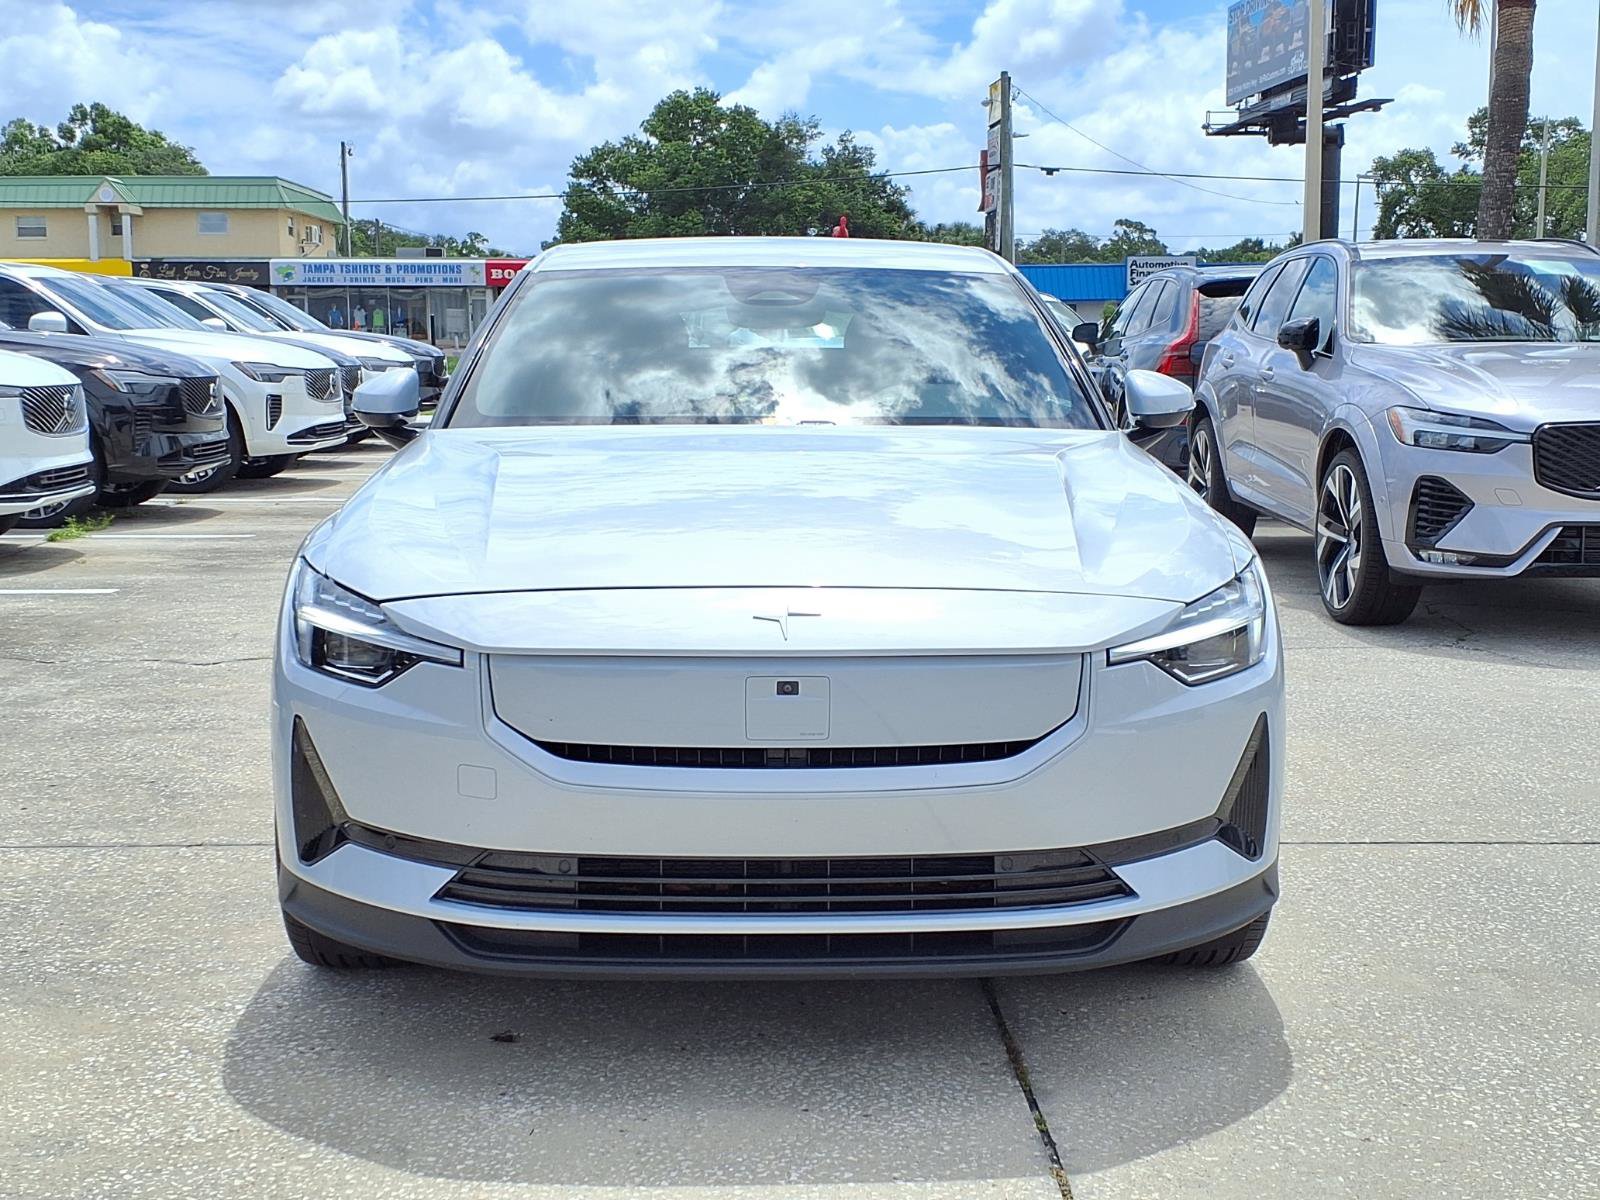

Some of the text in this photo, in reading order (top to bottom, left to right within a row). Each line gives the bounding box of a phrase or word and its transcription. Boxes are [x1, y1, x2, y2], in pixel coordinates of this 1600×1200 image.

[303, 264, 462, 274] TAMPA TSHIRTS & PROMOTIONS
[490, 268, 516, 279] BO
[1130, 269, 1154, 278] Fina
